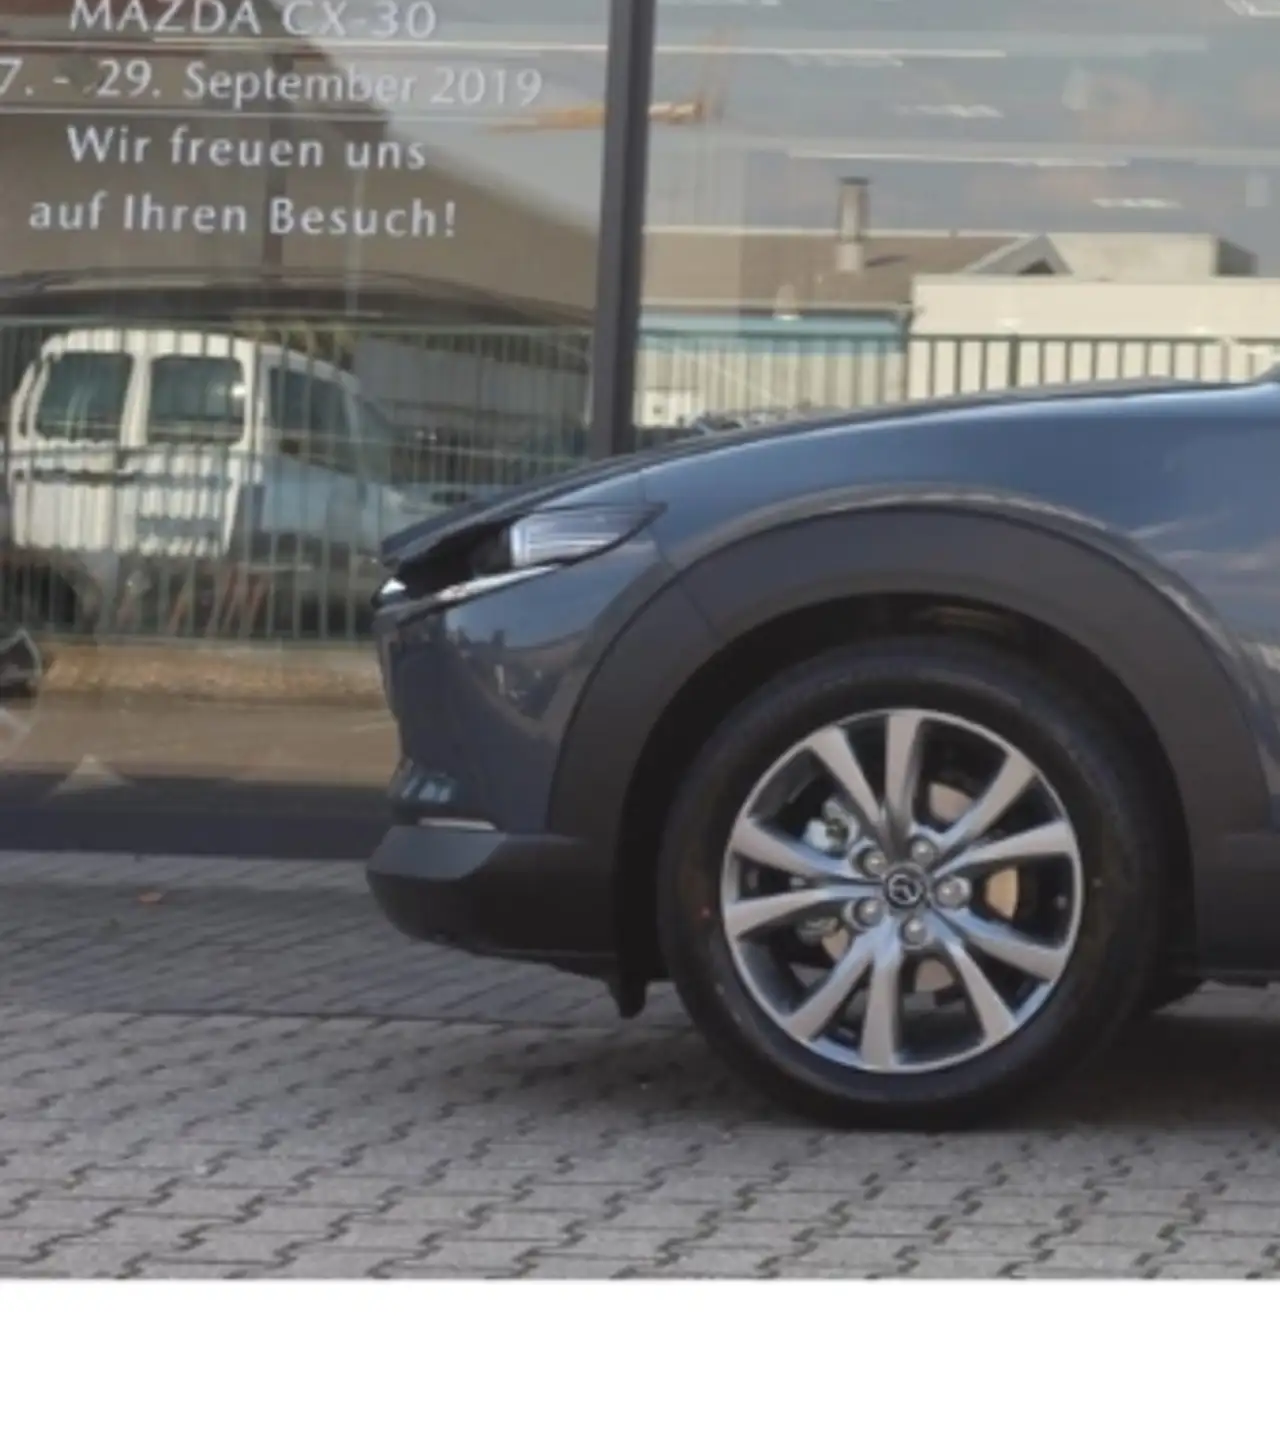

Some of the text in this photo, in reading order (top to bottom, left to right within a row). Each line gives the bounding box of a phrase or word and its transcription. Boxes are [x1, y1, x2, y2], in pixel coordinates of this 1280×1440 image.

[96, 58, 161, 100] 29.
[183, 61, 418, 111] September
[430, 66, 543, 106] 2019
[66, 123, 427, 171] Wir freuen uns
[28, 190, 456, 238] auf Ihren Besuch!
